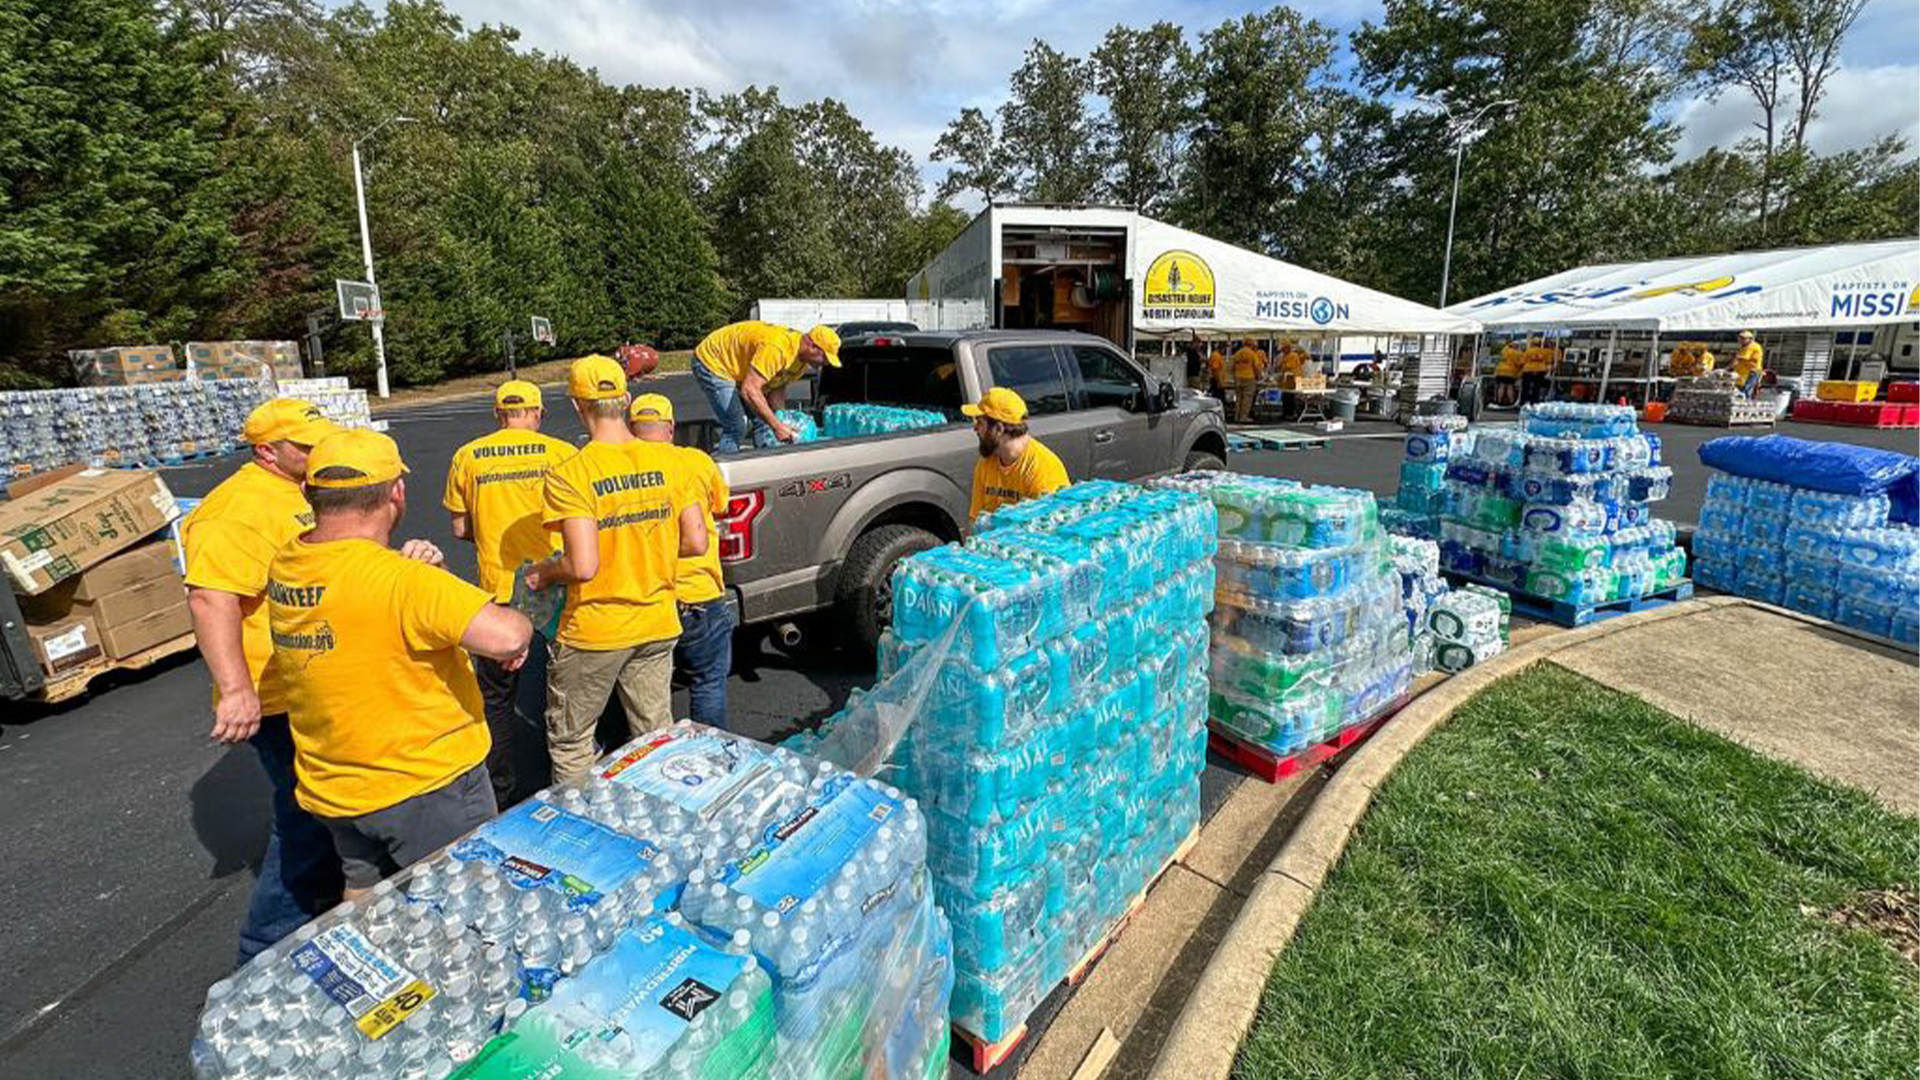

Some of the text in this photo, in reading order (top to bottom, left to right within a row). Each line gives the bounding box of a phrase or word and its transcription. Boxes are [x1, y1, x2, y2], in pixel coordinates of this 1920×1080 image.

[1833, 281, 1907, 291] BAPTISTS ON
[1148, 294, 1211, 304] DISASTER RELIEF
[1142, 308, 1215, 320] NORTH CAROLINA
[473, 443, 547, 459] VOLUNTEER
[394, 989, 423, 1011] 40
